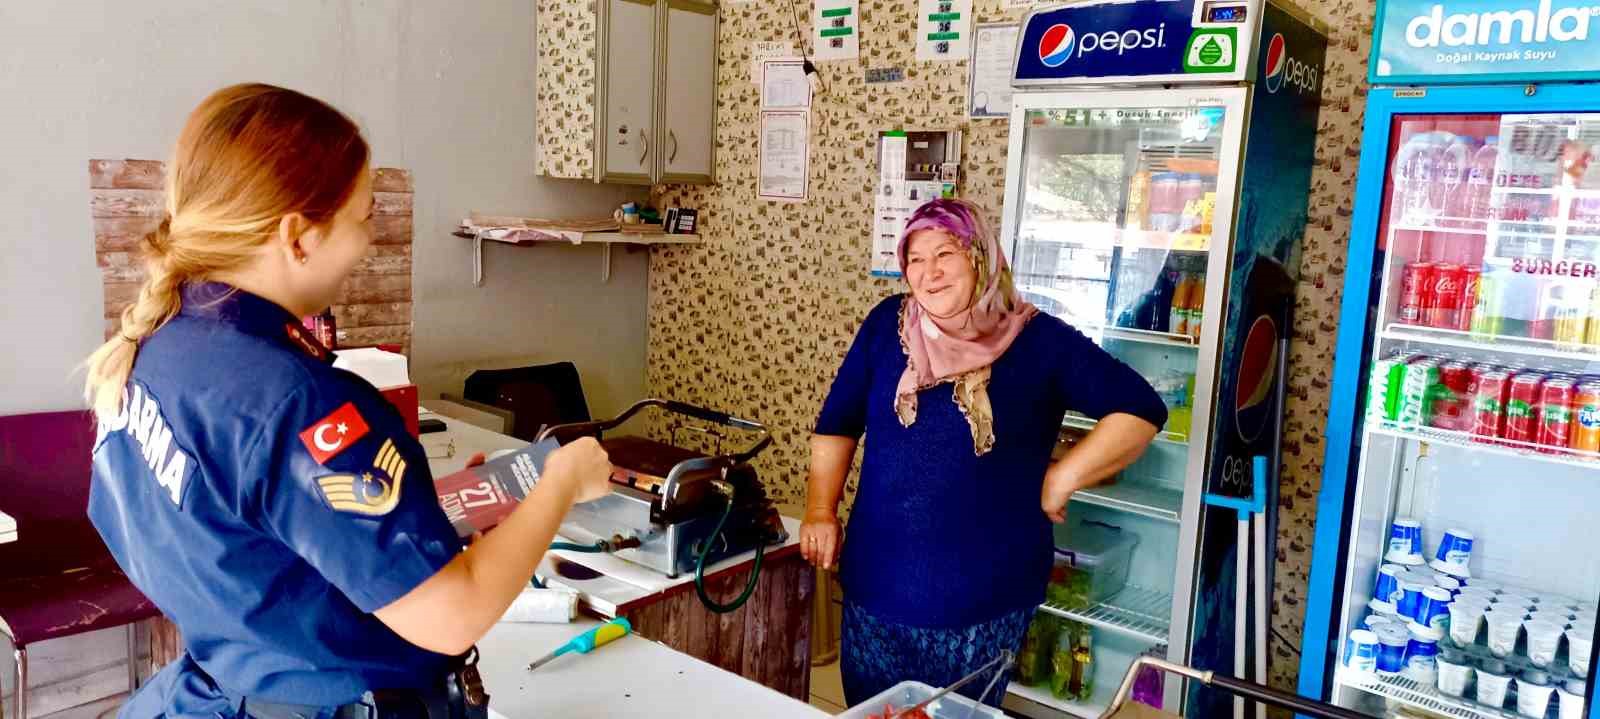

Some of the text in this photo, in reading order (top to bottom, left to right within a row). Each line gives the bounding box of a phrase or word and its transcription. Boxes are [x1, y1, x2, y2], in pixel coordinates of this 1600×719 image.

[1077, 23, 1164, 58] pepsi
[1405, 0, 1590, 48] damla
[1281, 56, 1319, 92] pepsi
[1436, 49, 1557, 65] Doğal Kaynak Suyu
[1512, 255, 1597, 278] BURGER
[1220, 455, 1251, 495] pep
[459, 481, 498, 508] 27
